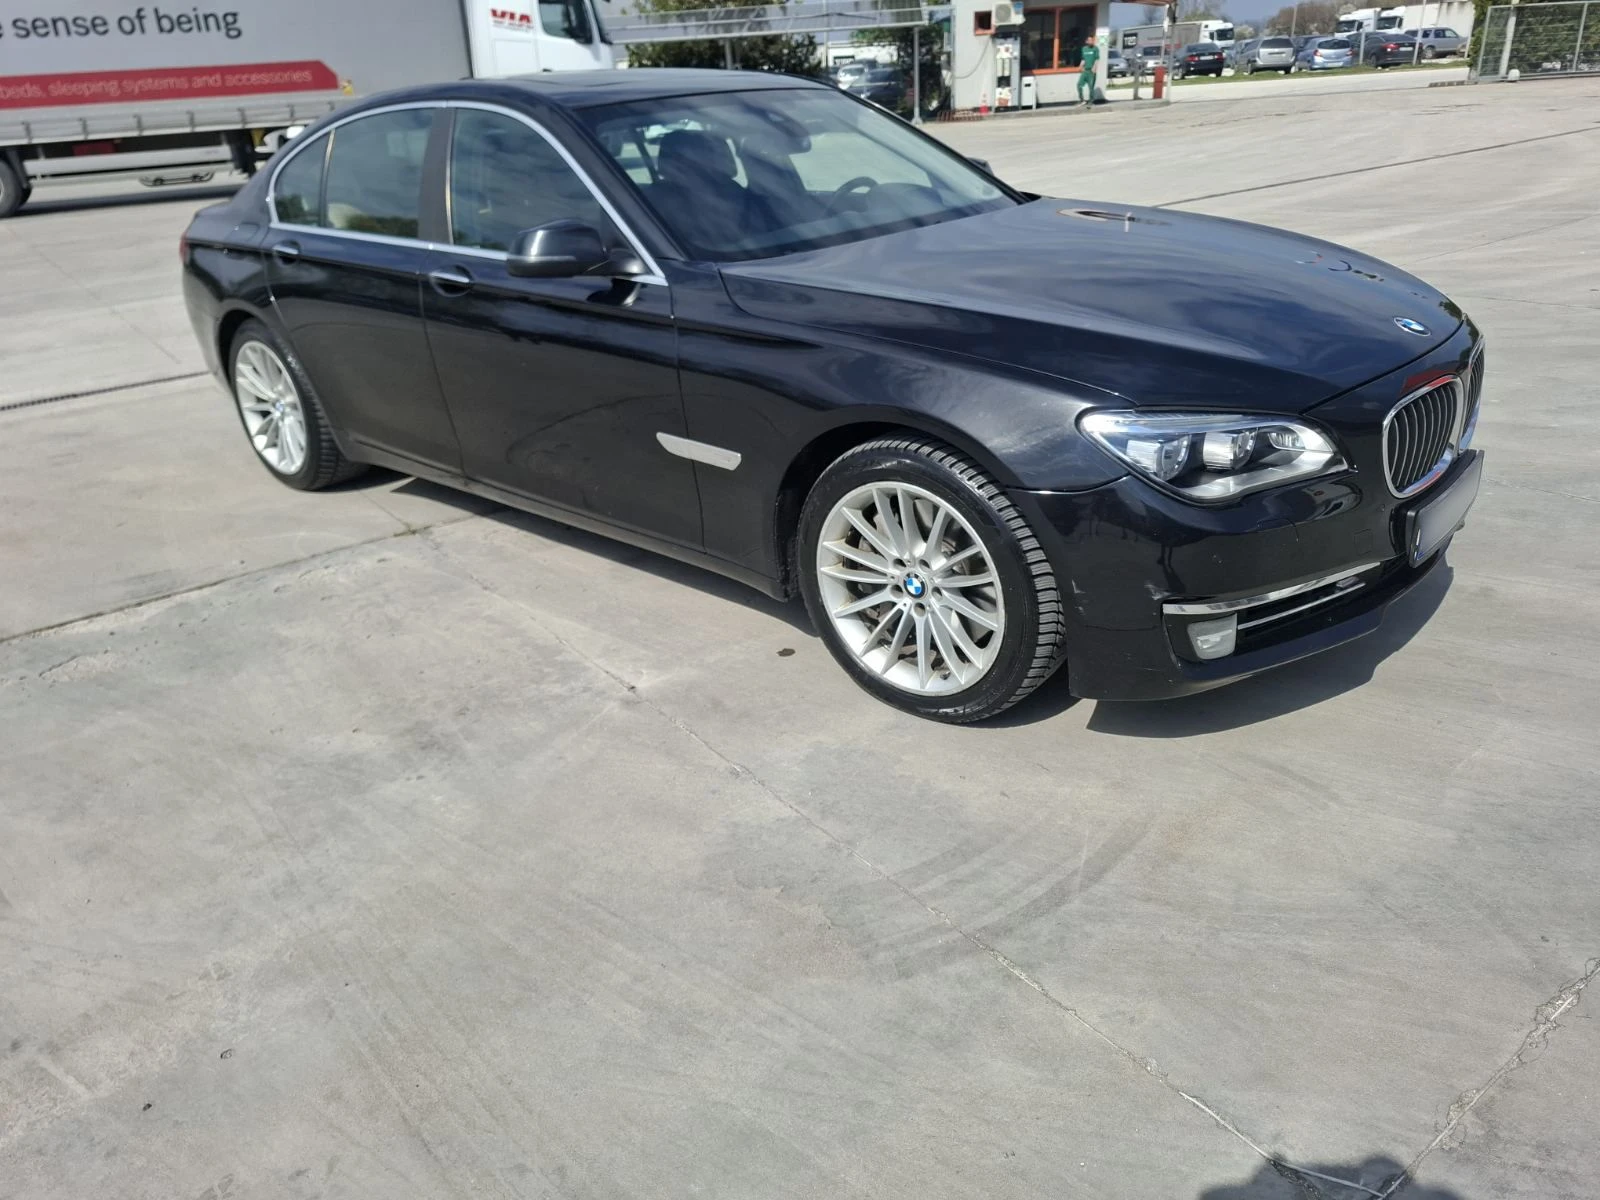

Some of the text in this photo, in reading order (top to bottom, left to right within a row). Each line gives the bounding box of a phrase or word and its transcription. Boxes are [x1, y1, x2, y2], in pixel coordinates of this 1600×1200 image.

[11, 16, 108, 39] sense
[117, 8, 146, 36] of
[155, 8, 242, 39] being
[48, 80, 120, 97] sleeping
[121, 77, 188, 95] systems
[191, 72, 221, 89] and
[224, 70, 312, 87] accessories
